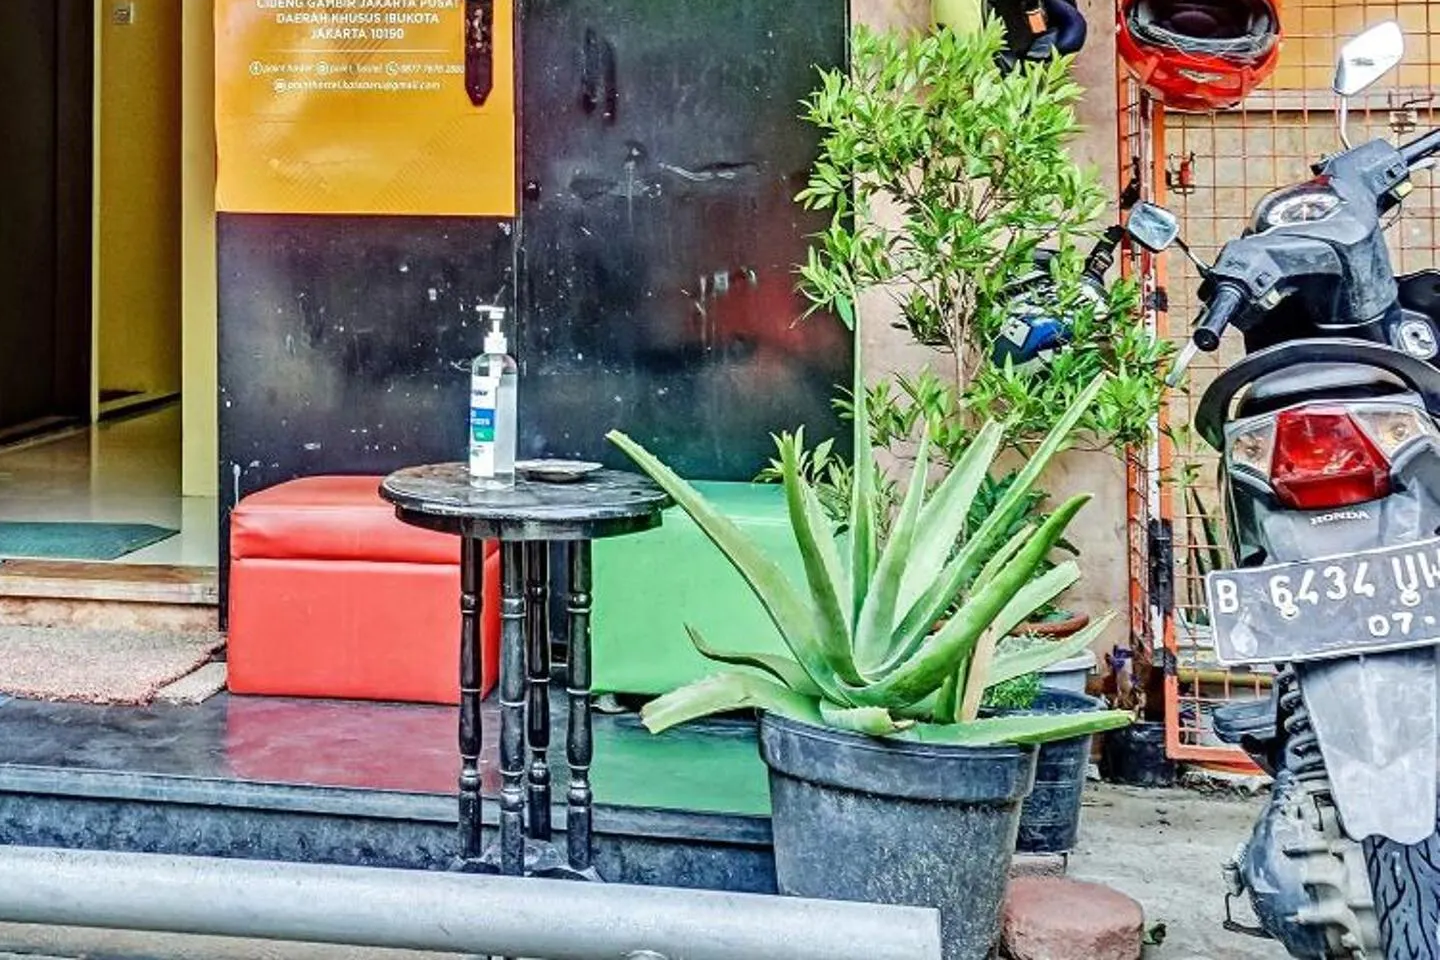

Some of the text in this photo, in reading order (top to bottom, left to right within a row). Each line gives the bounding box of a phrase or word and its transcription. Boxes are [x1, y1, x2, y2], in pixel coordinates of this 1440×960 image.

[276, 12, 440, 24] DAERAH KHUSUS IBUKOTA
[311, 28, 367, 39] JAKARTA
[1310, 511, 1371, 526] HONDA
[1216, 579, 1239, 613] B
[1270, 562, 1375, 613] 6434
